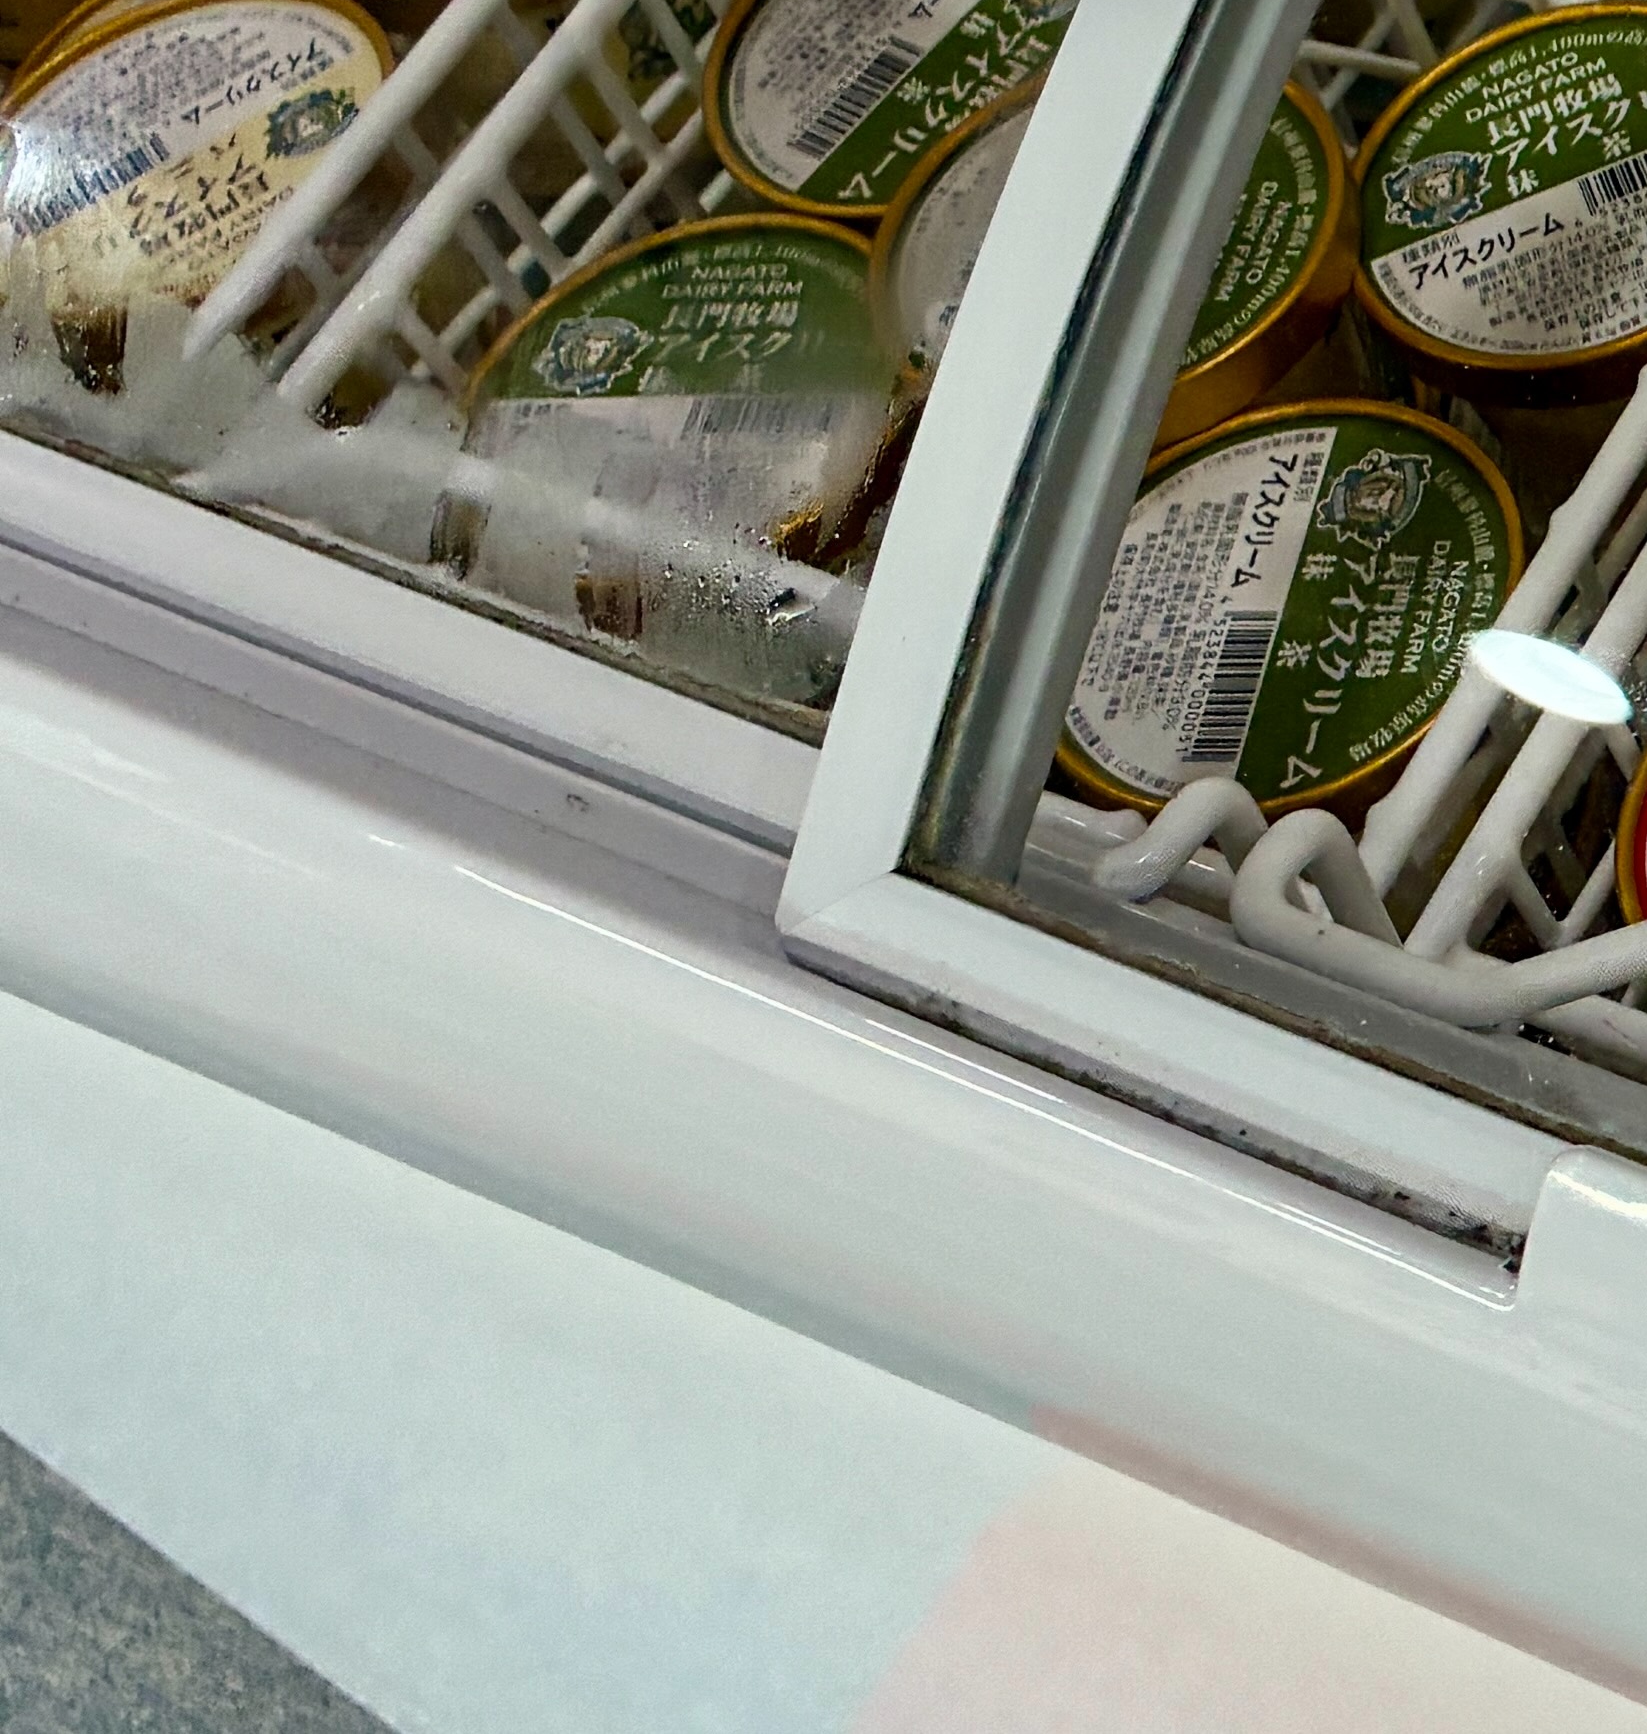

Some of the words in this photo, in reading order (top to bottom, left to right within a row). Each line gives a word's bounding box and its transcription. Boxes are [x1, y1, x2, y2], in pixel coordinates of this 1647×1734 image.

[1464, 85, 1535, 122] DAIRY
[1539, 57, 1607, 92] FARM
[1480, 52, 1579, 97] NAGATO
[1408, 211, 1564, 286] アイスクリーム
[1233, 450, 1295, 592] アイスクリーム
[1356, 551, 1416, 680] 長門牧場
[1401, 608, 1431, 674] FARM
[1429, 559, 1468, 653] NAGATO
[1281, 550, 1376, 794] アイスクリーム
